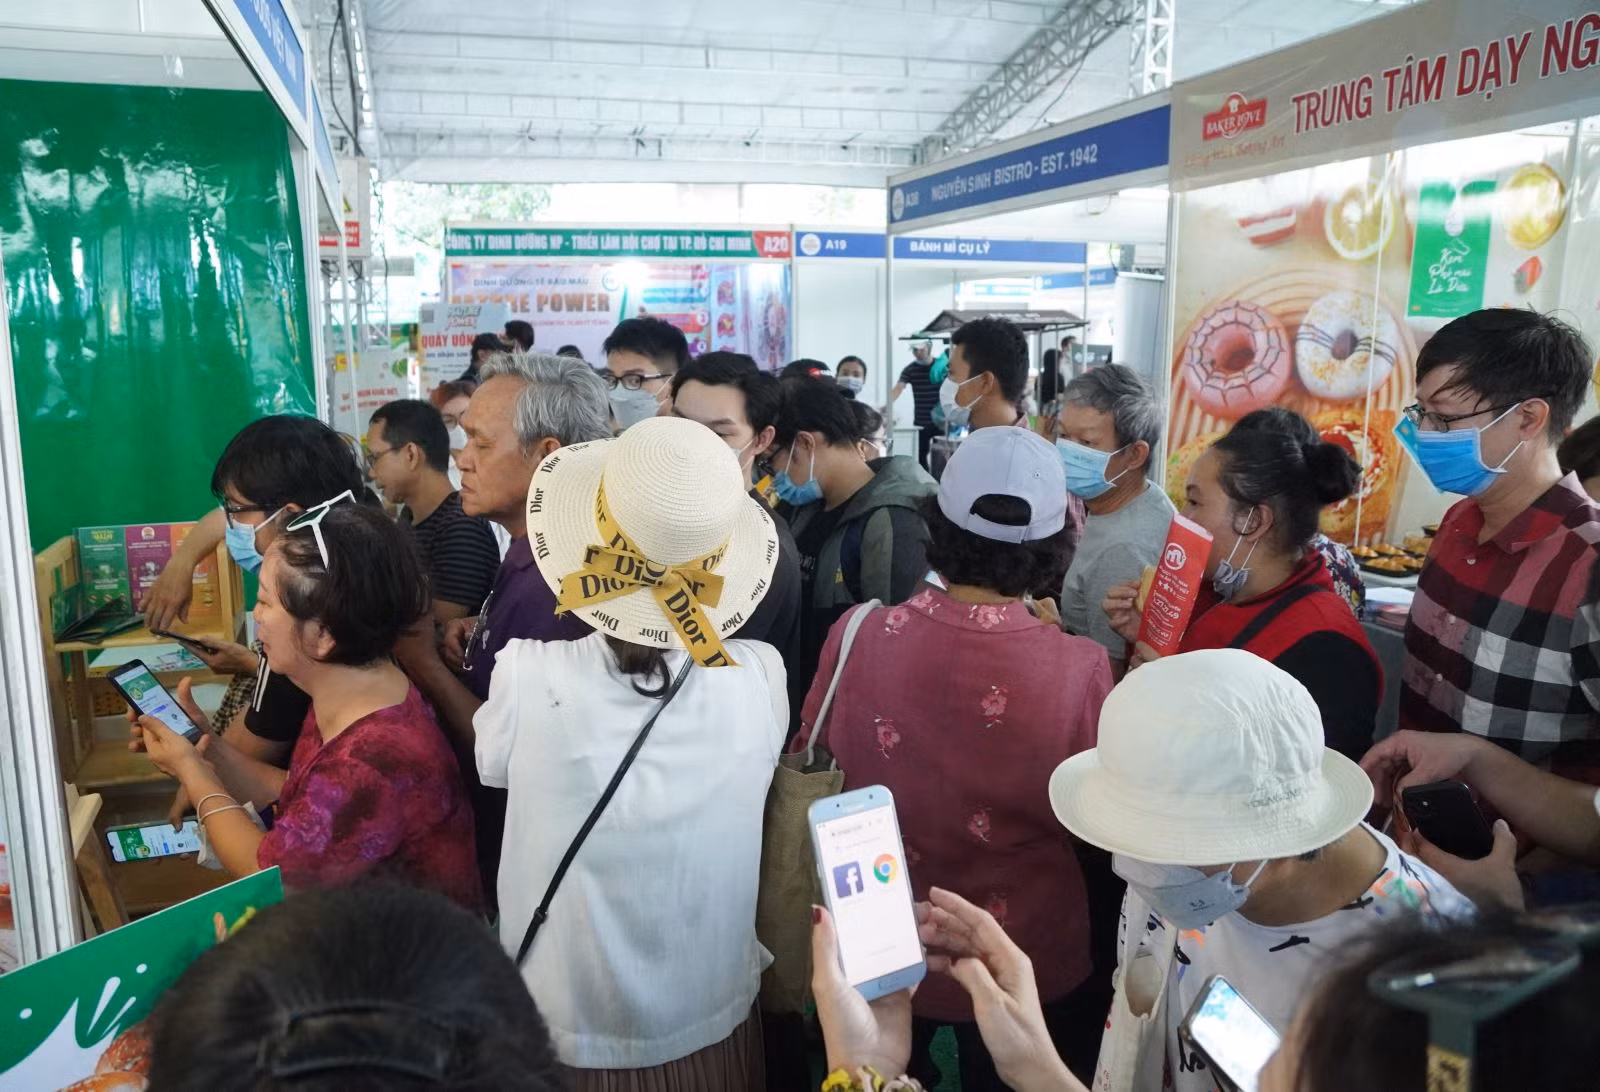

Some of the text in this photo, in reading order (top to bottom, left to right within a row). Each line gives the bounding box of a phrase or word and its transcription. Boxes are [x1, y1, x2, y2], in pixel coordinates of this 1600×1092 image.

[1292, 12, 1600, 134] TRUNG TÂM DẠY NG
[968, 172, 991, 193] SINH
[994, 160, 1033, 185] BISTRO
[473, 235, 486, 250] TY
[763, 235, 788, 252] A20
[825, 239, 847, 250] A19
[910, 239, 941, 253] BÁNH
[958, 242, 974, 256] CỤ
[976, 240, 991, 254] LÝ
[537, 292, 610, 313] POWER
[452, 330, 478, 347] UỐN
[541, 456, 561, 473] Dior
[530, 487, 544, 514] Dior
[535, 532, 551, 560] Dior
[766, 539, 776, 565] Dior
[579, 574, 637, 599] Dio
[751, 578, 767, 601] Dior
[591, 610, 620, 632] Dior
[664, 588, 708, 646] Dior
[721, 611, 744, 632] Dior
[638, 627, 669, 643] Dior
